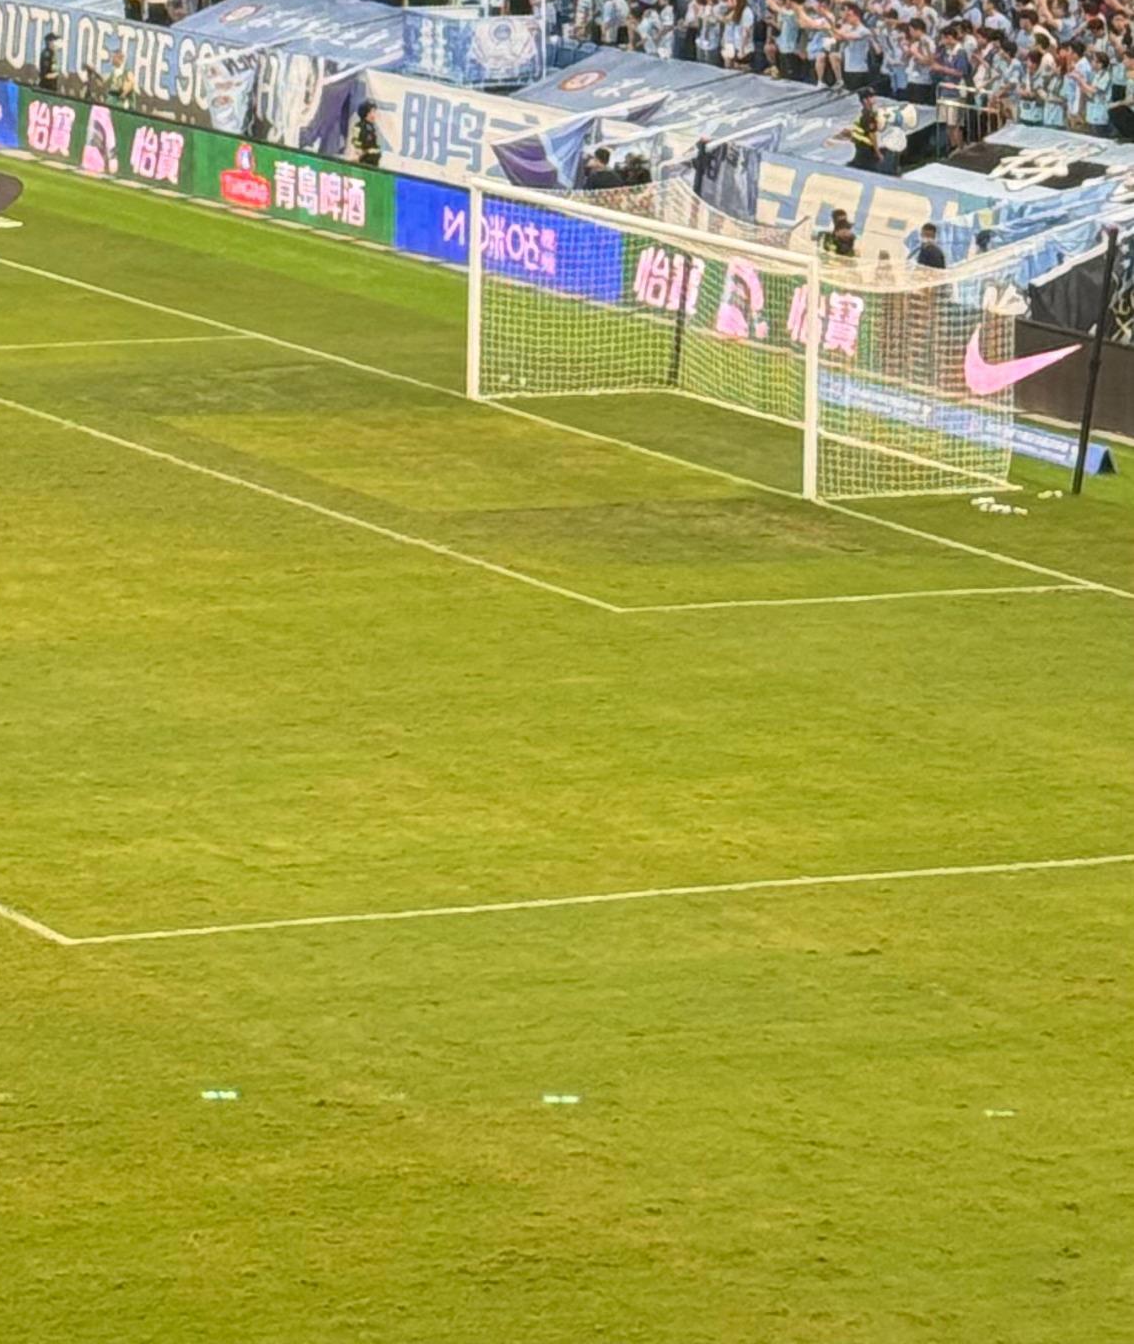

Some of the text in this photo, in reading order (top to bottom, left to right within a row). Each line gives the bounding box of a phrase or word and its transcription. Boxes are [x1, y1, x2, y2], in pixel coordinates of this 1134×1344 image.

[75, 16, 112, 84] OF
[116, 22, 175, 101] THE
[26, 99, 76, 156] 怡寶
[129, 125, 185, 185] 怡寶
